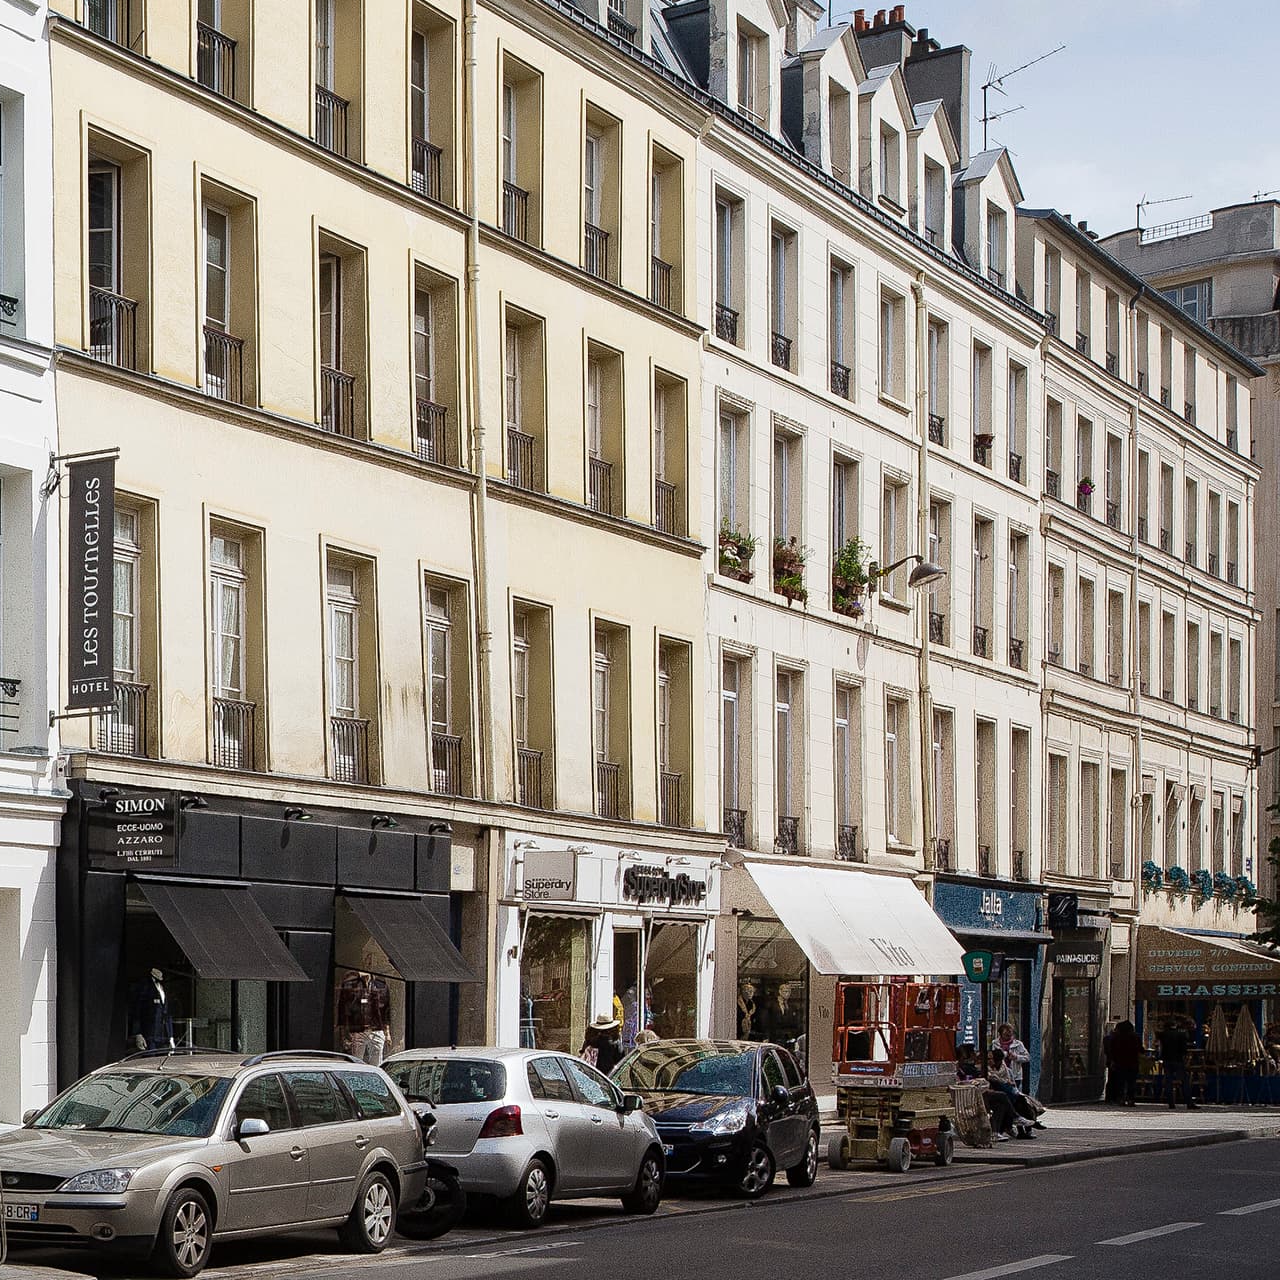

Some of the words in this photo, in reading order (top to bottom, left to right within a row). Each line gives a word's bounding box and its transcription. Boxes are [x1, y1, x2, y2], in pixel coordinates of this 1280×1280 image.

[72, 681, 110, 694] HOTEL
[115, 798, 165, 813] SIMON
[117, 823, 163, 832] ECCE-UOMO
[117, 835, 163, 844] AZZARO
[525, 879, 571, 891] Superdry
[1149, 964, 1205, 973] SERVICE
[1211, 963, 1274, 972] CONTINU
[1157, 984, 1280, 996] BRASSER
